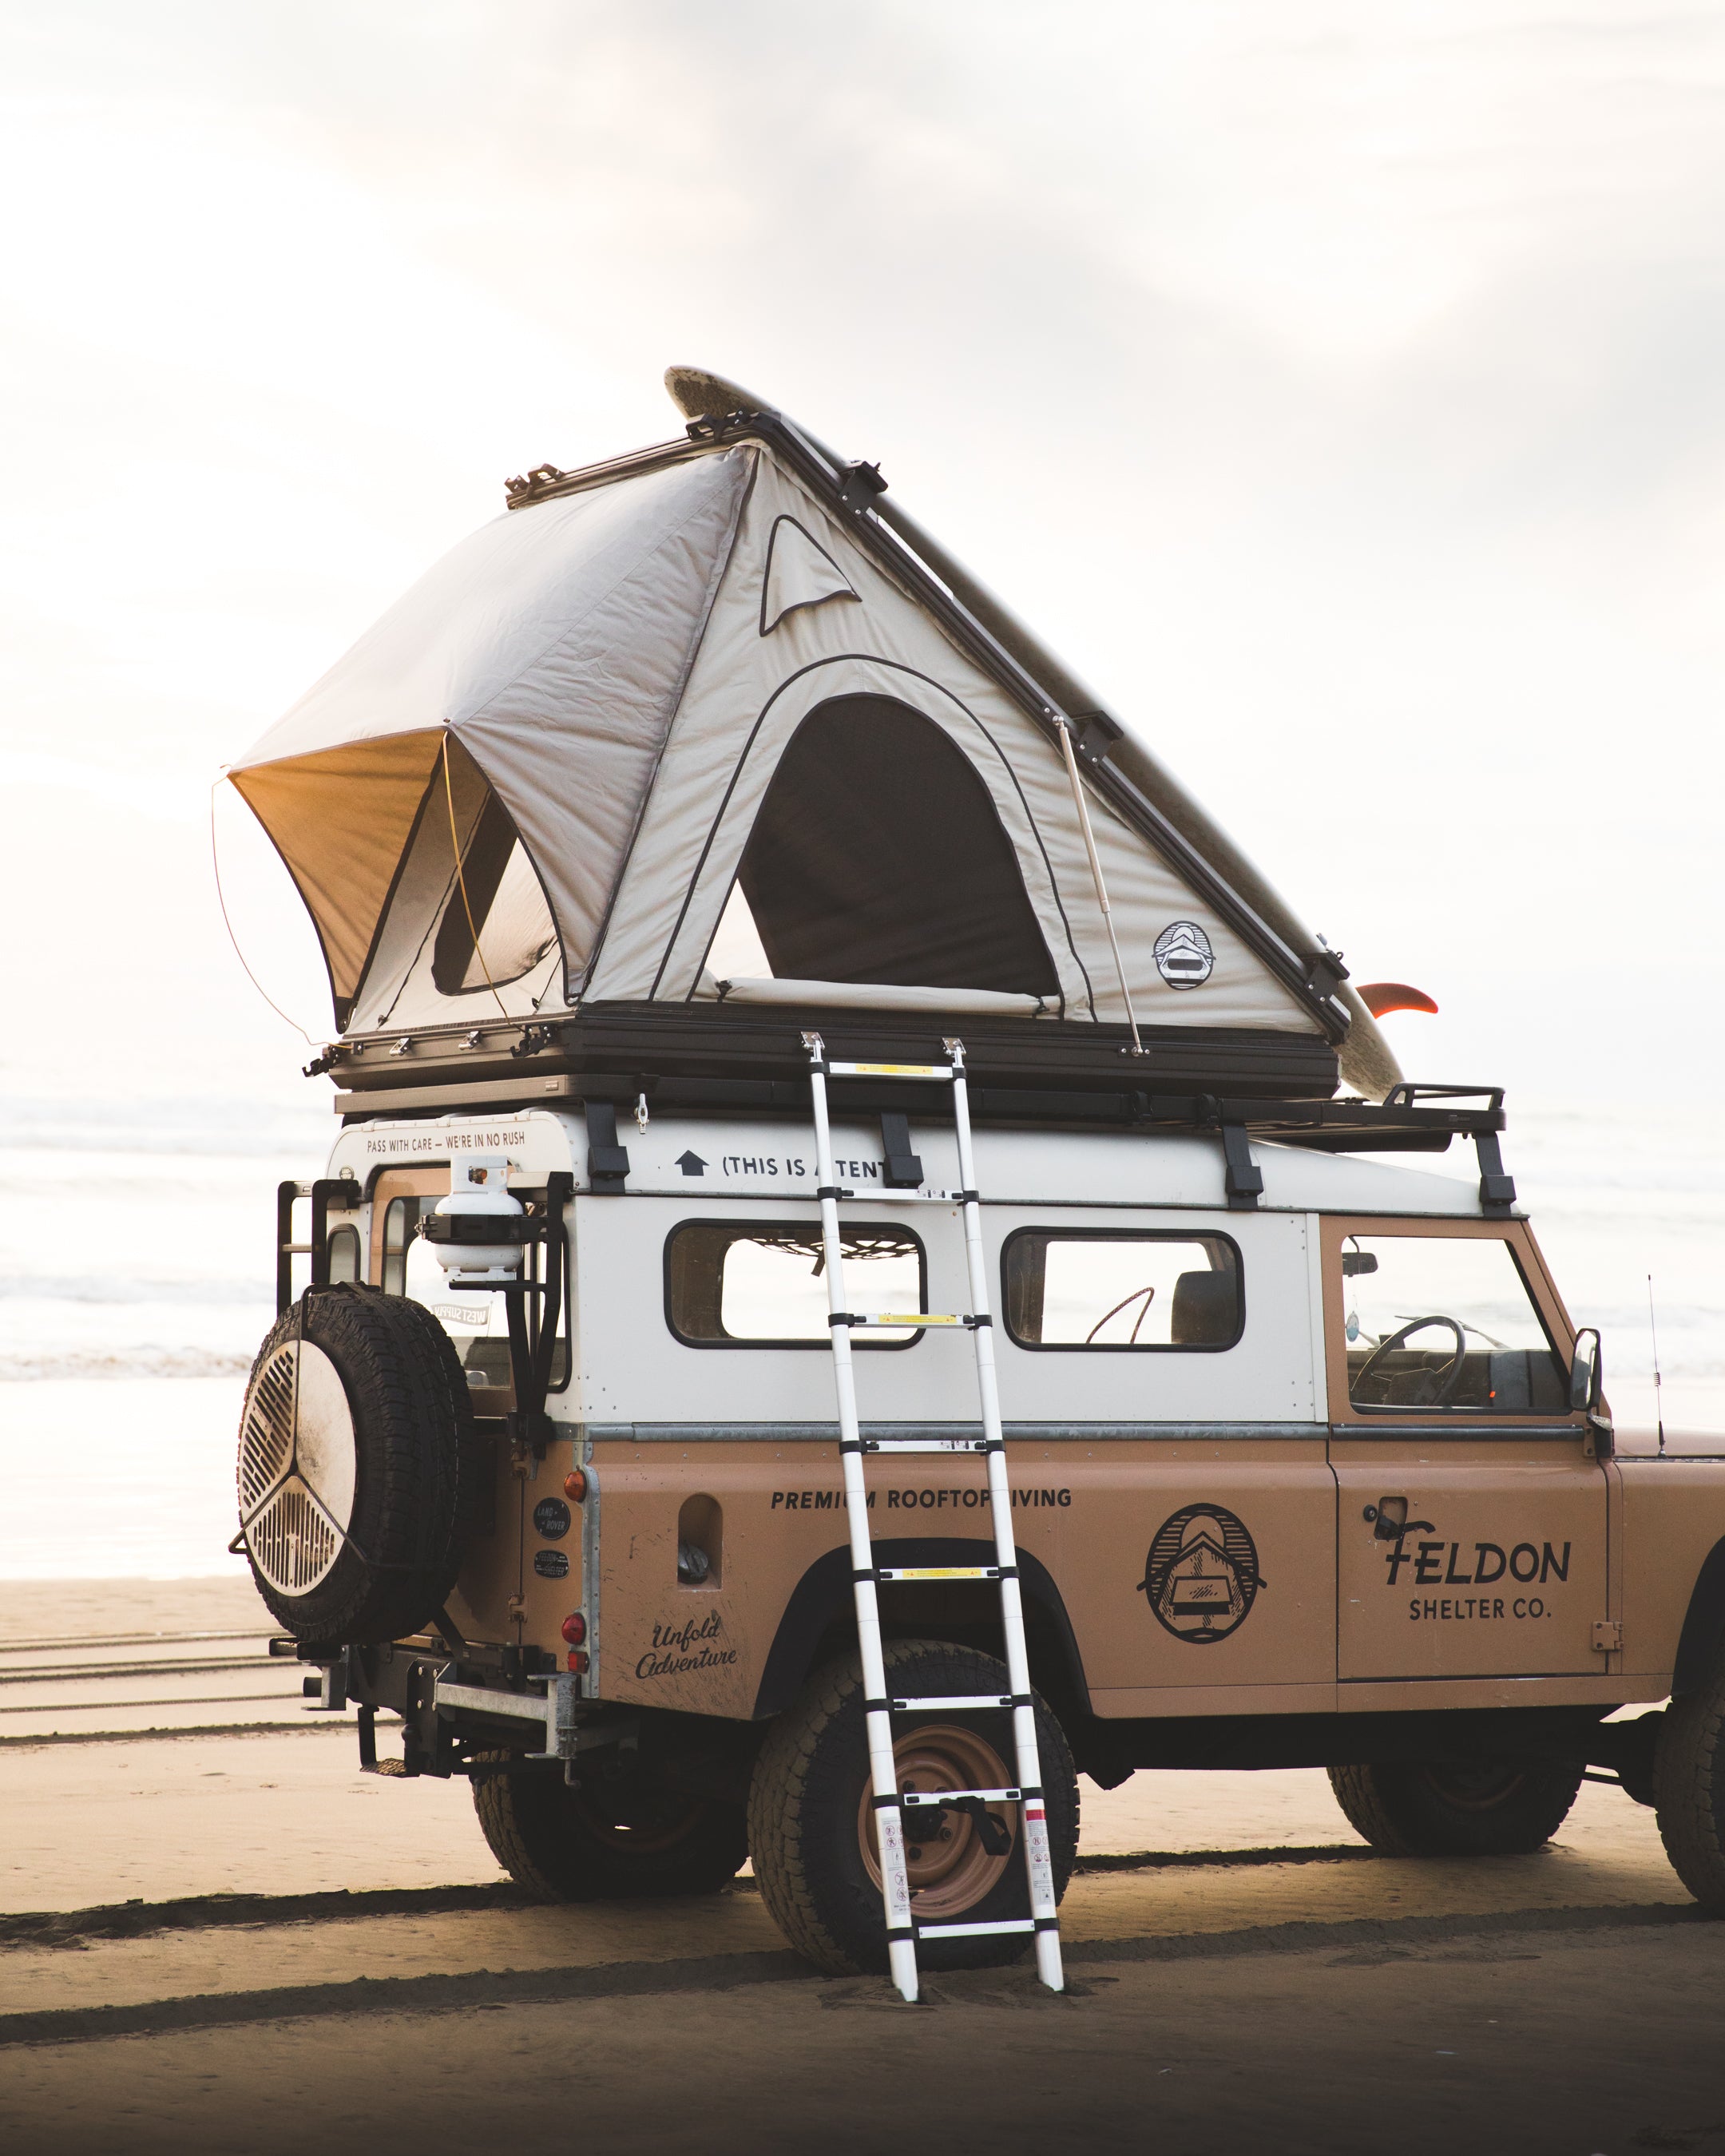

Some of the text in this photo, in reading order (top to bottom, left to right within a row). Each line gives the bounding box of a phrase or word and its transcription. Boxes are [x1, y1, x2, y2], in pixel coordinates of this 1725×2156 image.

[367, 1139, 386, 1152] PASS
[389, 1139, 409, 1151] WITH
[412, 1138, 432, 1151] CARE
[446, 1135, 471, 1148] WE'RE
[474, 1134, 484, 1147] IN
[486, 1132, 500, 1147] NO
[503, 1131, 525, 1146] RUSH
[723, 1156, 778, 1176] (THIS
[786, 1159, 805, 1176] IS
[771, 1488, 1072, 1510] PREMIM ROOFTOP IVING
[537, 1508, 553, 1517] LAND
[546, 1520, 565, 1531] ROVER
[1386, 1520, 1572, 1585] FELDON
[1410, 1598, 1552, 1620] SHELTER CO.
[652, 1615, 722, 1652] Unfold
[635, 1647, 738, 1679] Adventure
